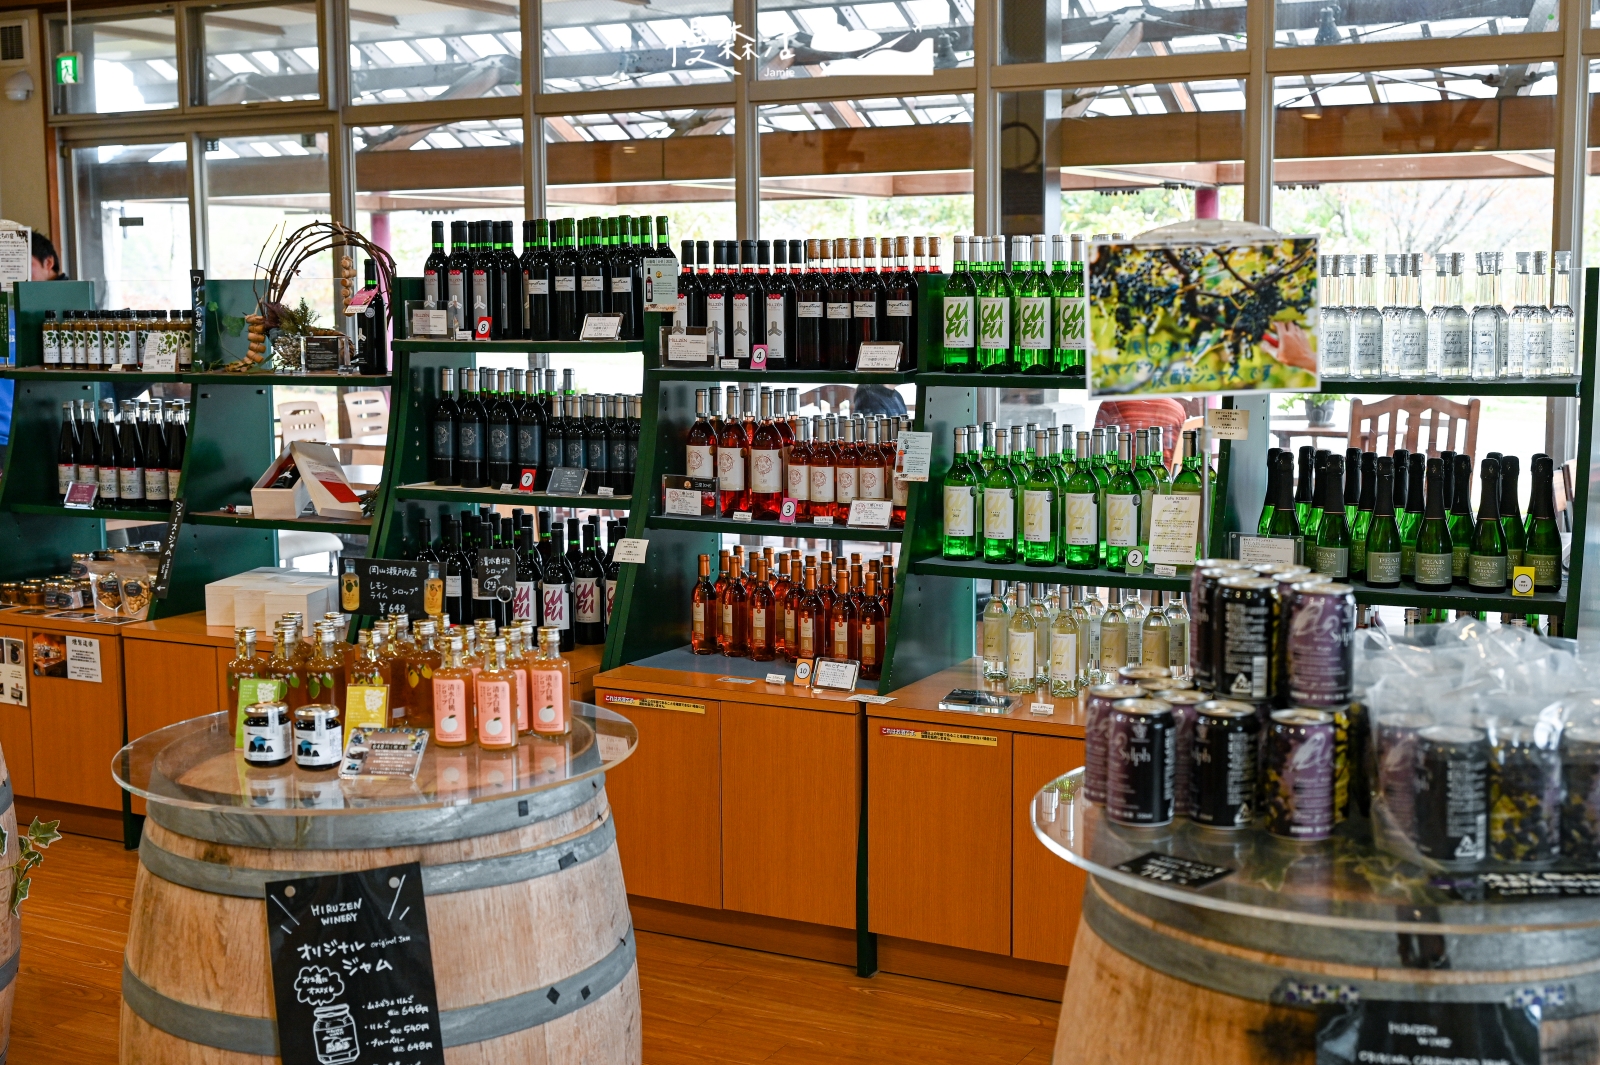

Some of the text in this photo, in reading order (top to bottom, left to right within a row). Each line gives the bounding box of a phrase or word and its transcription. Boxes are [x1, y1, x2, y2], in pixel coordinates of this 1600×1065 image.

[481, 323, 486, 331] 8
[756, 352, 761, 360] 4
[785, 505, 791, 513] 3
[480, 557, 511, 566] 清水白桃
[1132, 554, 1138, 563] 2
[369, 566, 417, 577] 岡山瀬戸内産
[486, 567, 508, 575] シロップ
[370, 582, 388, 590] レモン
[370, 592, 388, 600] ライム
[392, 587, 418, 596] シロップ
[388, 604, 406, 613] 648
[545, 674, 553, 701] 清水白桃
[447, 683, 455, 711] 清水白桃
[492, 685, 500, 713] 清水白桃
[311, 898, 362, 916] HIRUZEN
[321, 913, 357, 926] WINERY
[297, 939, 366, 961] オリジナル
[342, 957, 393, 976] ジャム
[401, 1004, 429, 1016] 648円
[403, 1023, 430, 1033] 540円
[407, 1041, 433, 1052] 648円
